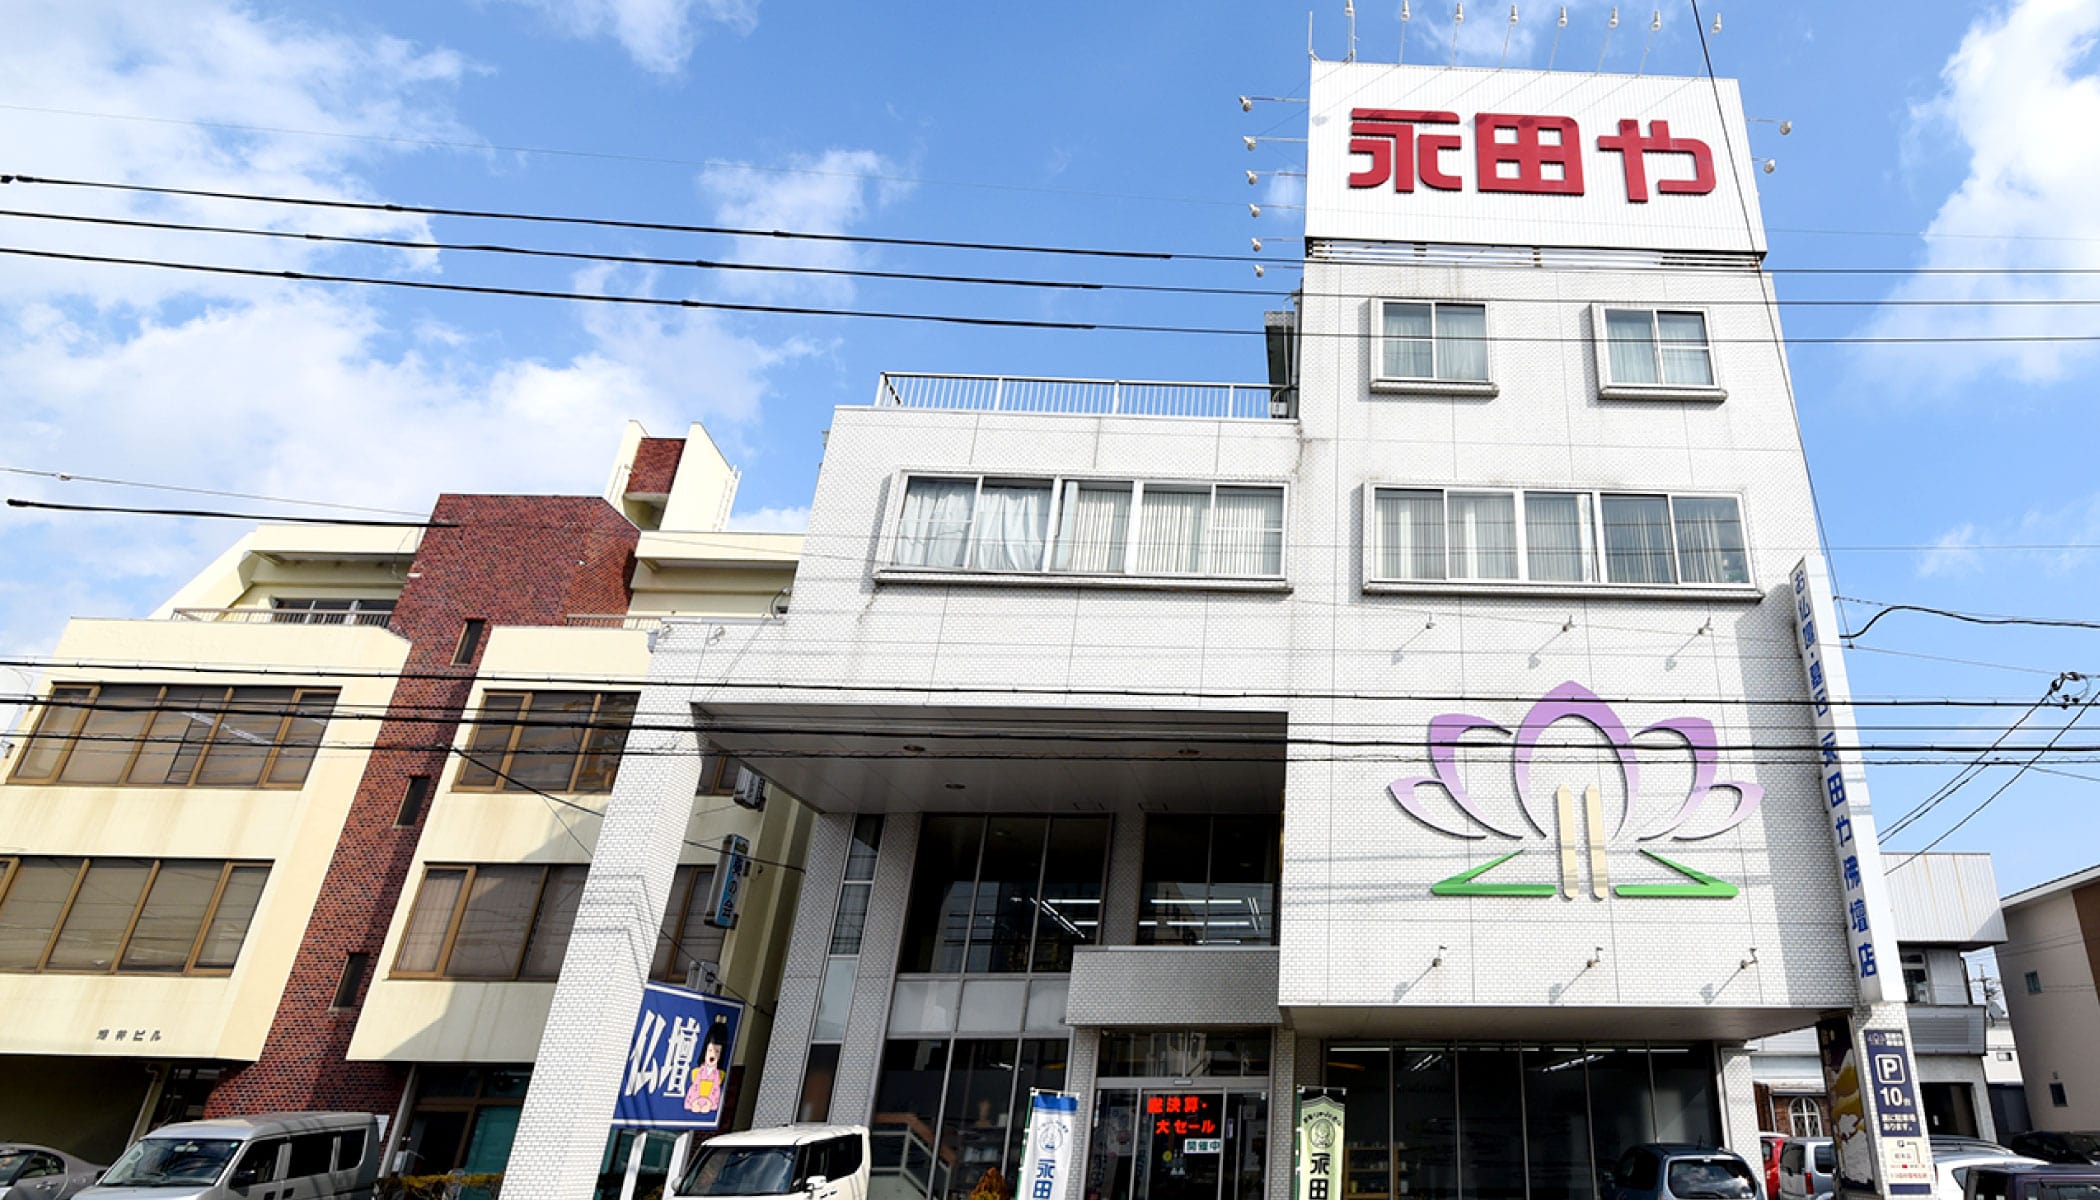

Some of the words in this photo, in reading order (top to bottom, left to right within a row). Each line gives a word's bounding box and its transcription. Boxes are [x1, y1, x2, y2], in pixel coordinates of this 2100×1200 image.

[1349, 107, 1716, 203] 永田や
[625, 1009, 700, 1098] 仏壇
[1882, 1058, 1898, 1080] P
[1155, 1118, 1216, 1135] 大セール
[1308, 1152, 1331, 1200] 永田
